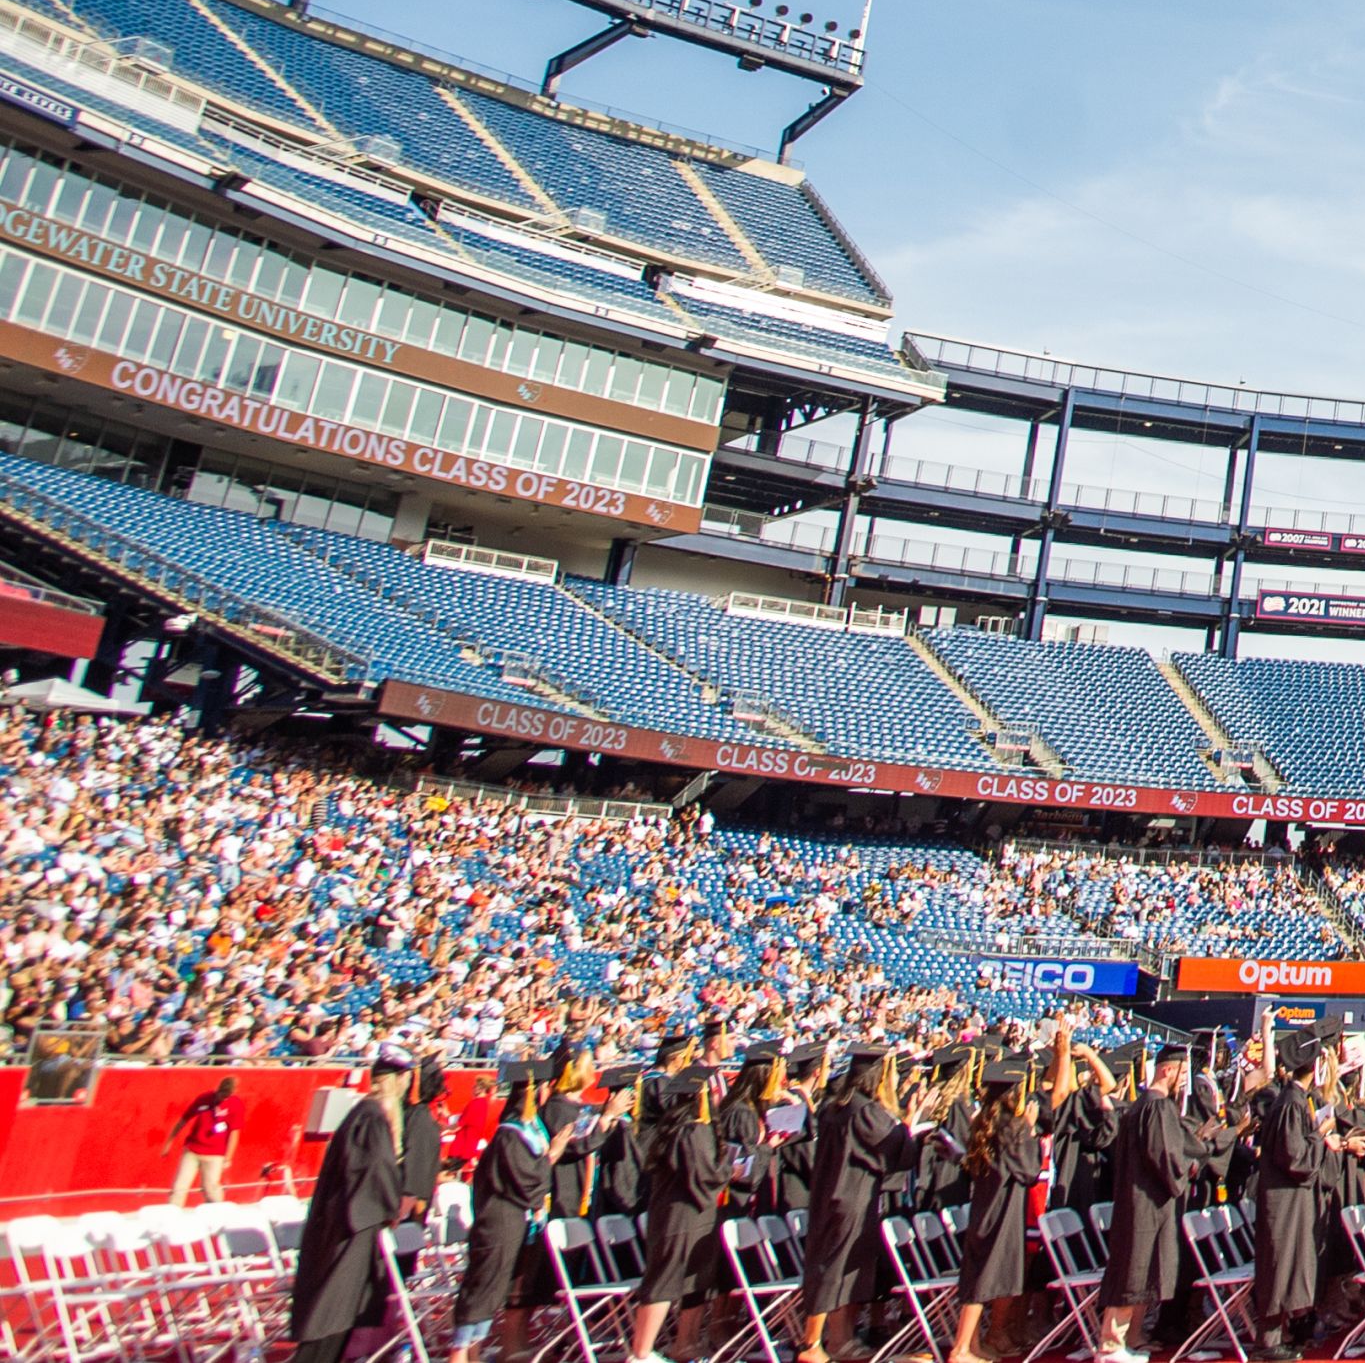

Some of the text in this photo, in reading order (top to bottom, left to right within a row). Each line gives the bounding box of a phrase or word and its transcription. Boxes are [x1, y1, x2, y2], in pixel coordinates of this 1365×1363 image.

[149, 263, 234, 312] STATE
[238, 295, 402, 364] UNIVERSITY
[111, 361, 405, 467] CONGRATULATIONS
[413, 447, 507, 492] CLASS
[515, 472, 559, 500] OF
[562, 482, 626, 516] 2023
[1282, 533, 1304, 545] 2007
[1288, 597, 1326, 615] 2021
[476, 702, 546, 736] CLASS
[549, 719, 576, 742] OF
[581, 725, 628, 751] 2023
[716, 745, 790, 774] CLASS
[976, 776, 1138, 808] CLASS OF 2023
[1232, 795, 1304, 821] CLASS
[1308, 799, 1340, 821] OF
[1238, 961, 1332, 991] Optum
[1279, 1005, 1316, 1021] Optum
